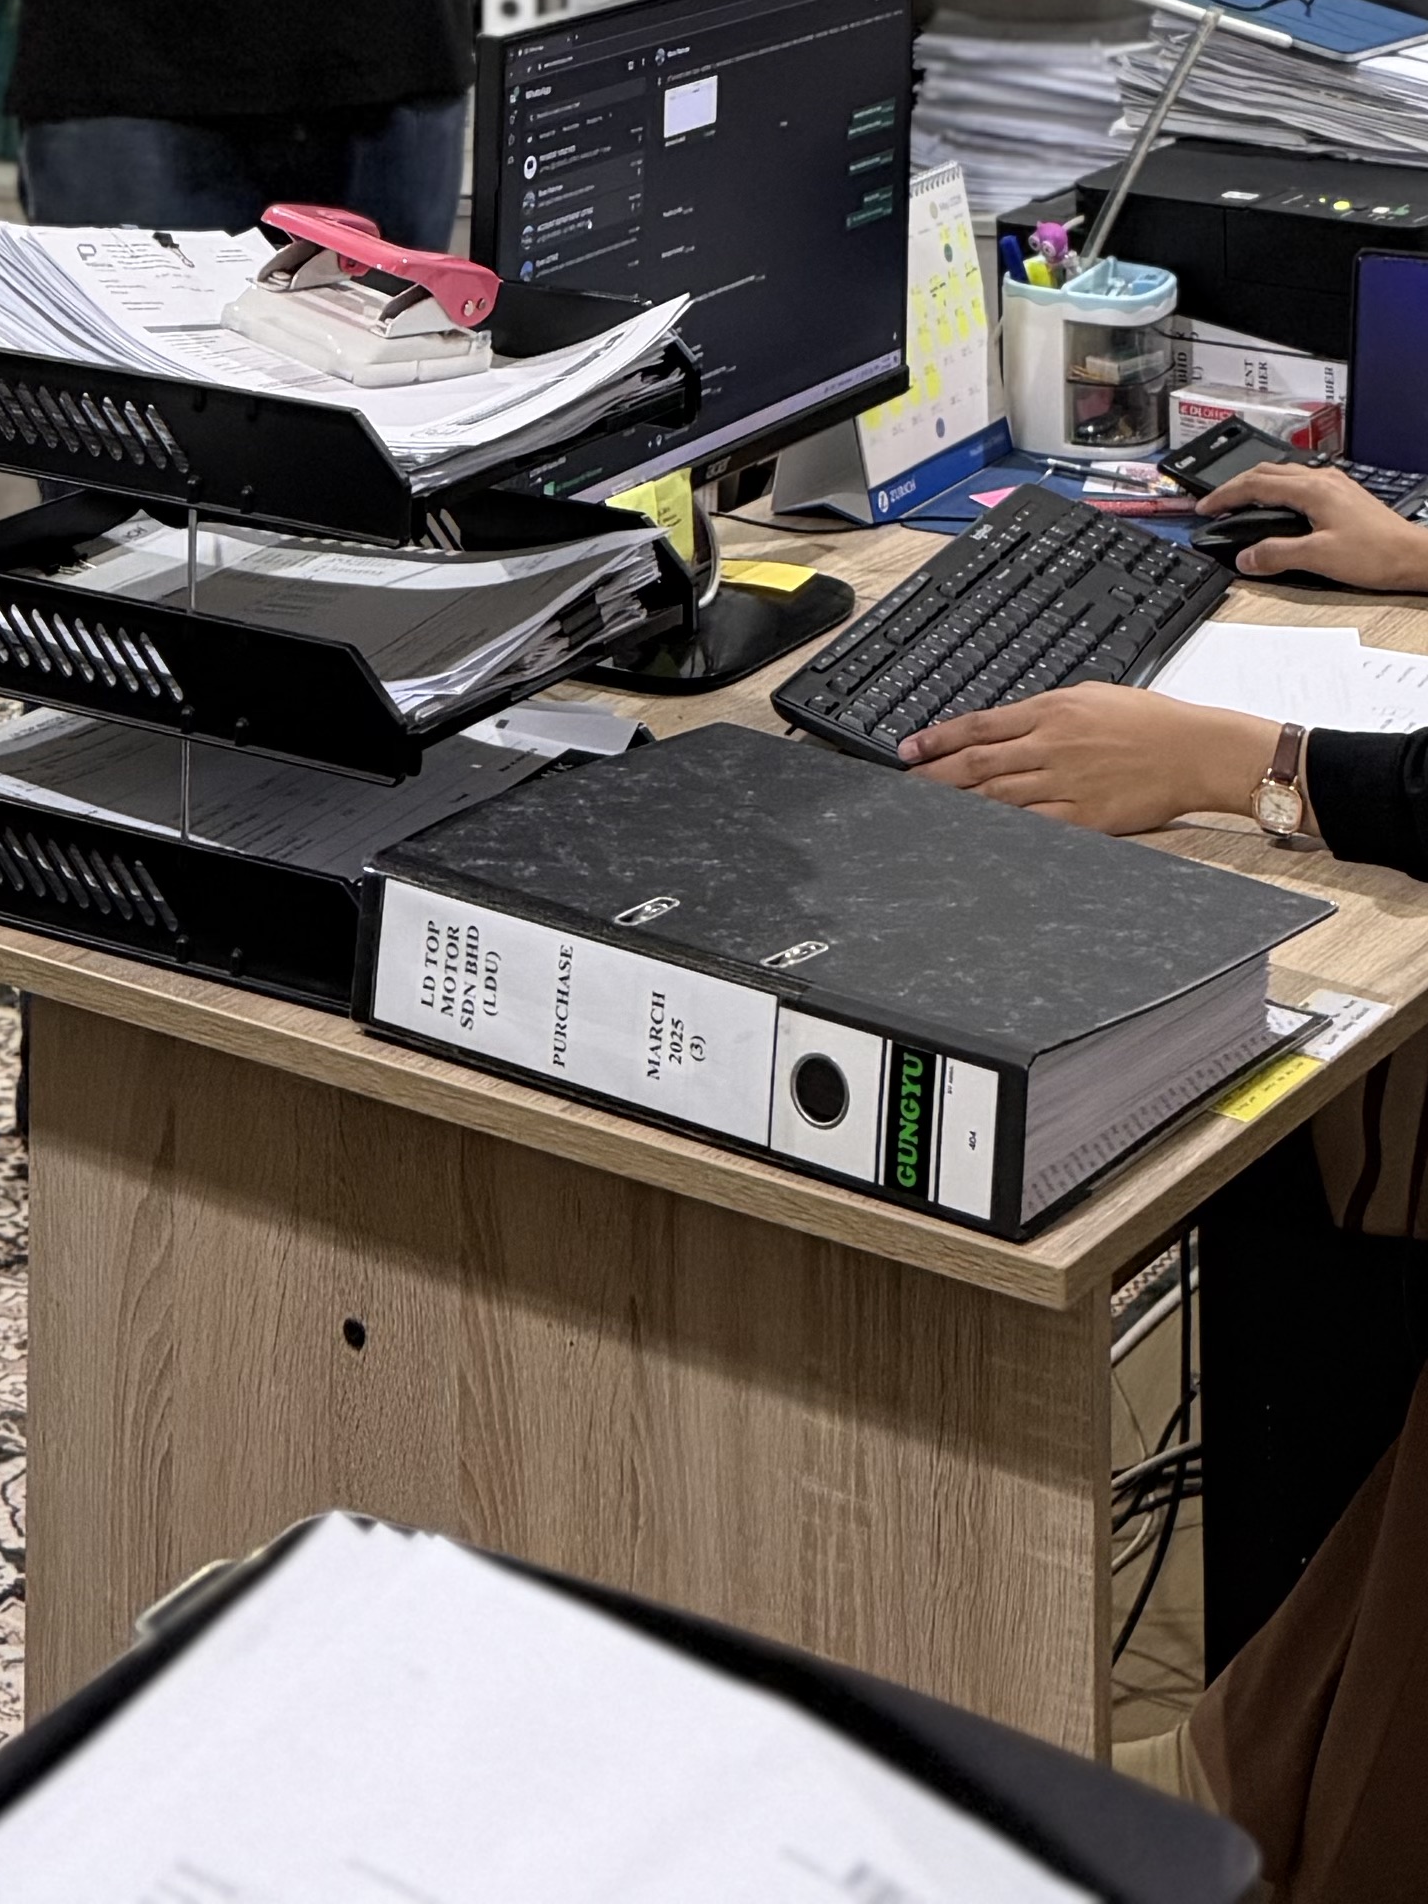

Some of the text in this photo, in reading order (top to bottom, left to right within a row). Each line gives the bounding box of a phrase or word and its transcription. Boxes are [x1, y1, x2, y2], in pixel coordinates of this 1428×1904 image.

[421, 920, 441, 1009] LD TOP
[441, 925, 460, 1017] MOTOR
[460, 925, 480, 1030] SDN BHD
[483, 950, 502, 1017] (LDU)
[553, 944, 574, 1068] PURCHASE
[647, 991, 666, 1081] MARCH
[669, 1018, 685, 1065] 2025
[690, 1035, 707, 1062] (3)
[896, 1052, 924, 1188] GUNGYU
